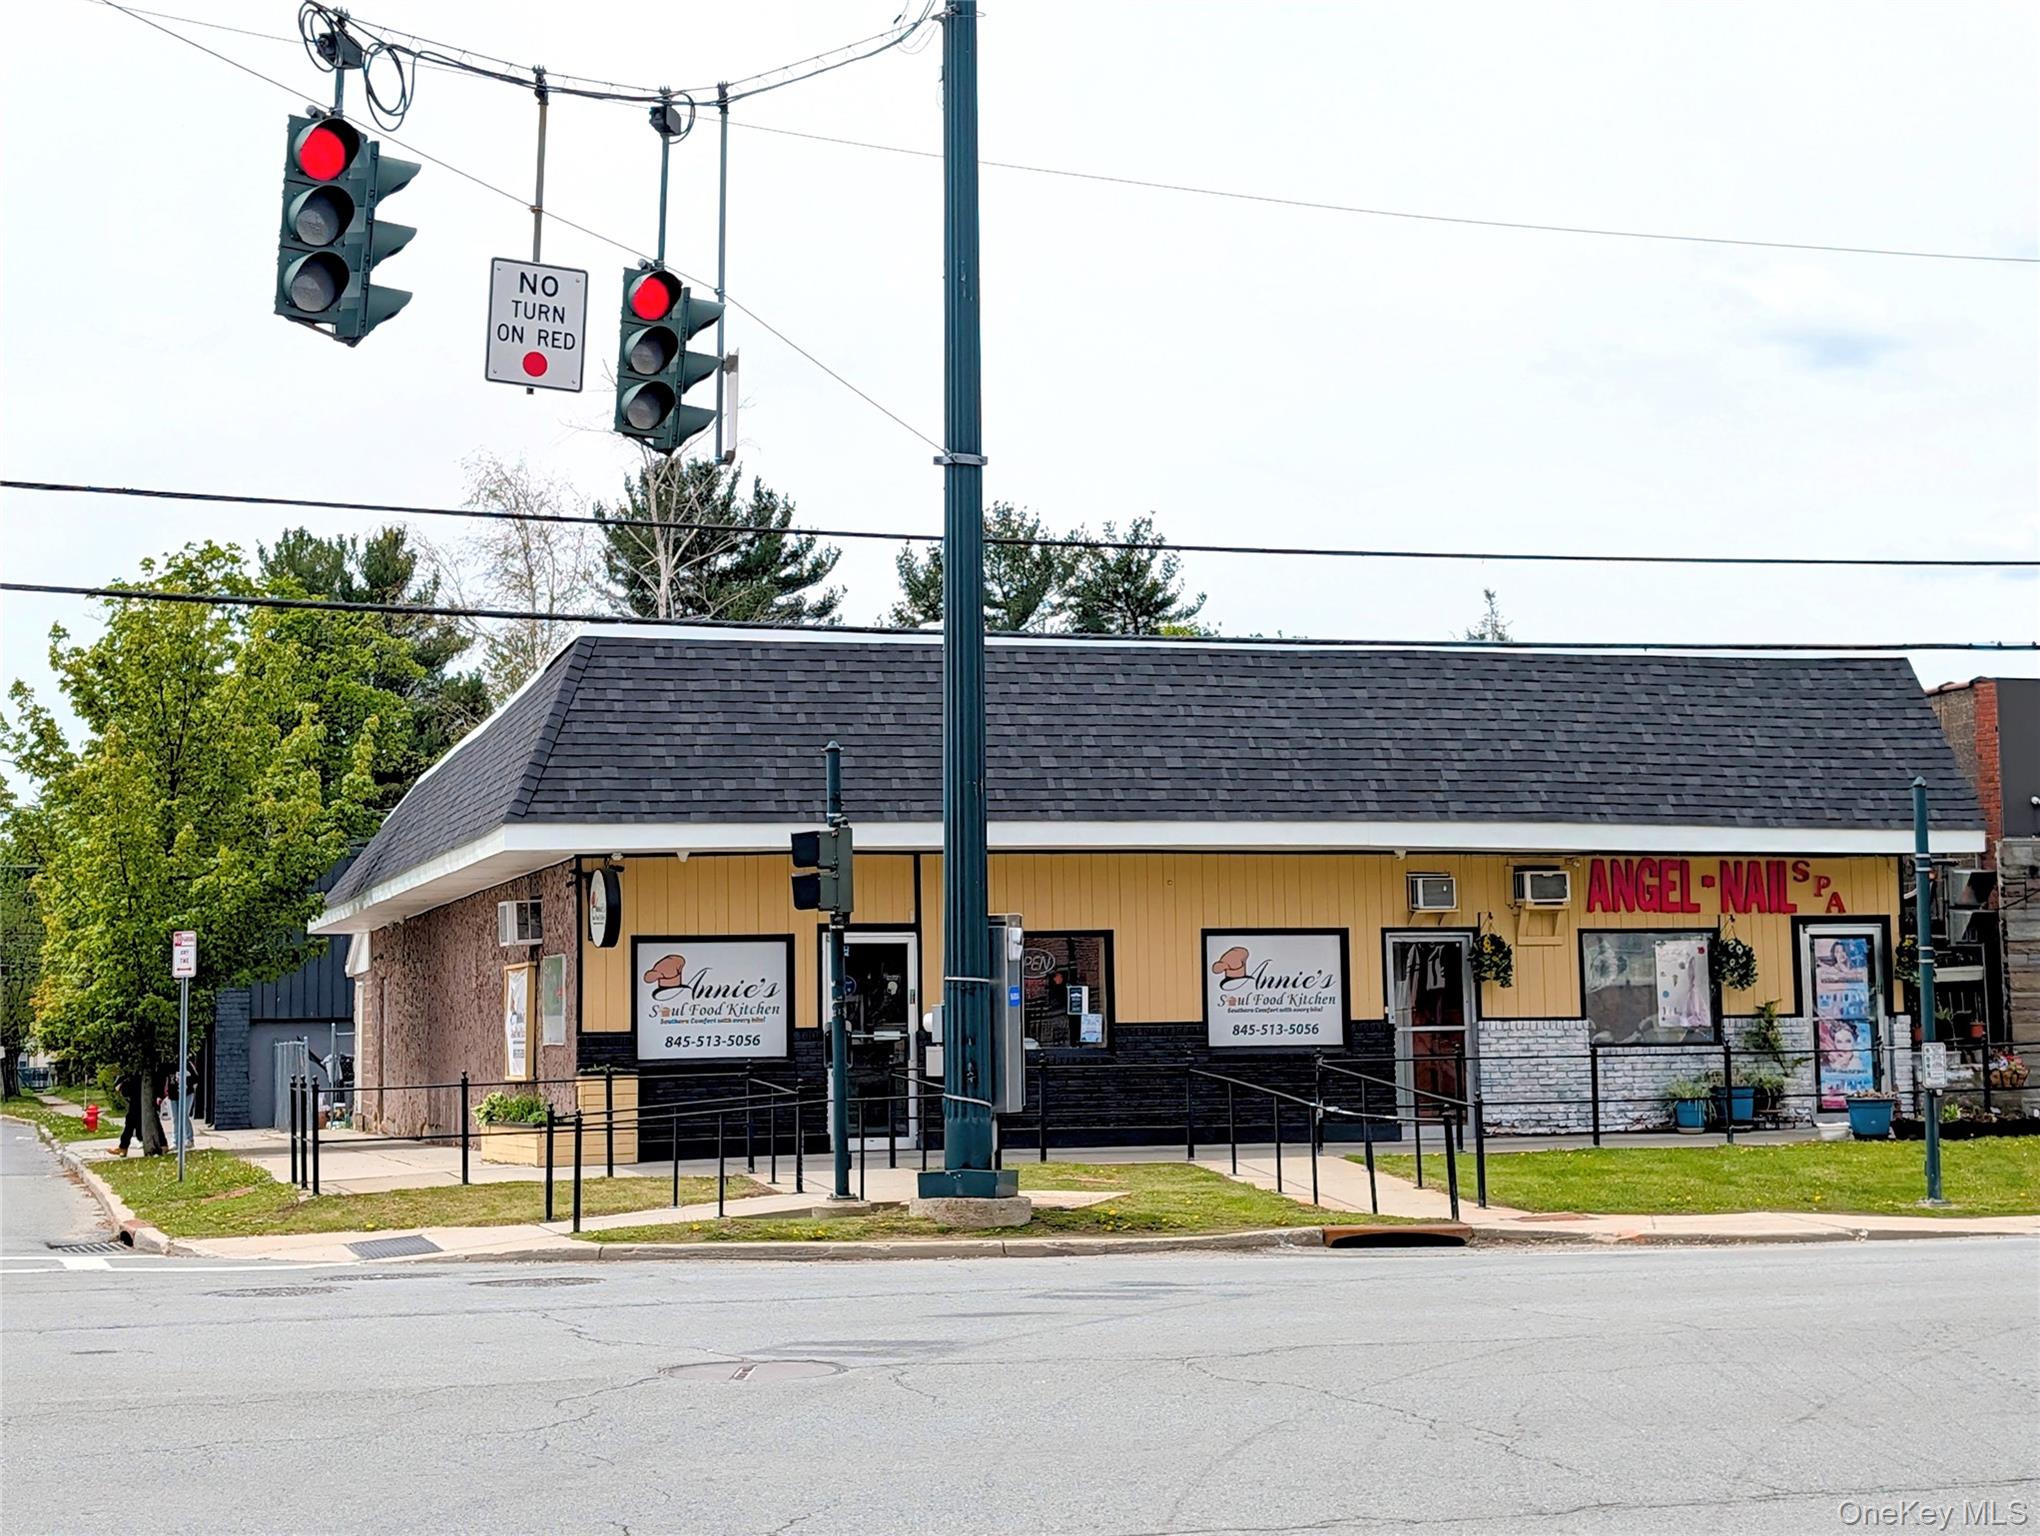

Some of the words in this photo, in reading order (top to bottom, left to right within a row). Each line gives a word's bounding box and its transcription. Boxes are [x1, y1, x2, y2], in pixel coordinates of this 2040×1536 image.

[519, 271, 559, 298] NO
[511, 299, 565, 325] TURN
[496, 323, 525, 344] ON
[537, 329, 576, 351] RED
[1586, 857, 1701, 913] ANGEL
[1719, 859, 1797, 914] NAIL
[1791, 860, 1846, 914] SPA
[1024, 955, 1051, 972] PEN
[1219, 958, 1337, 992] Annie's
[651, 966, 781, 1002] Annie's
[649, 1002, 686, 1018] Sul
[689, 1001, 726, 1016] Food
[726, 1001, 781, 1018] Kitchen
[1217, 991, 1253, 1008] Sul
[1253, 991, 1287, 1007] Food
[1287, 991, 1337, 1008] Kitchen
[664, 1034, 761, 1049] 845-513-5056
[1232, 1023, 1320, 1036] 845-513-5056
